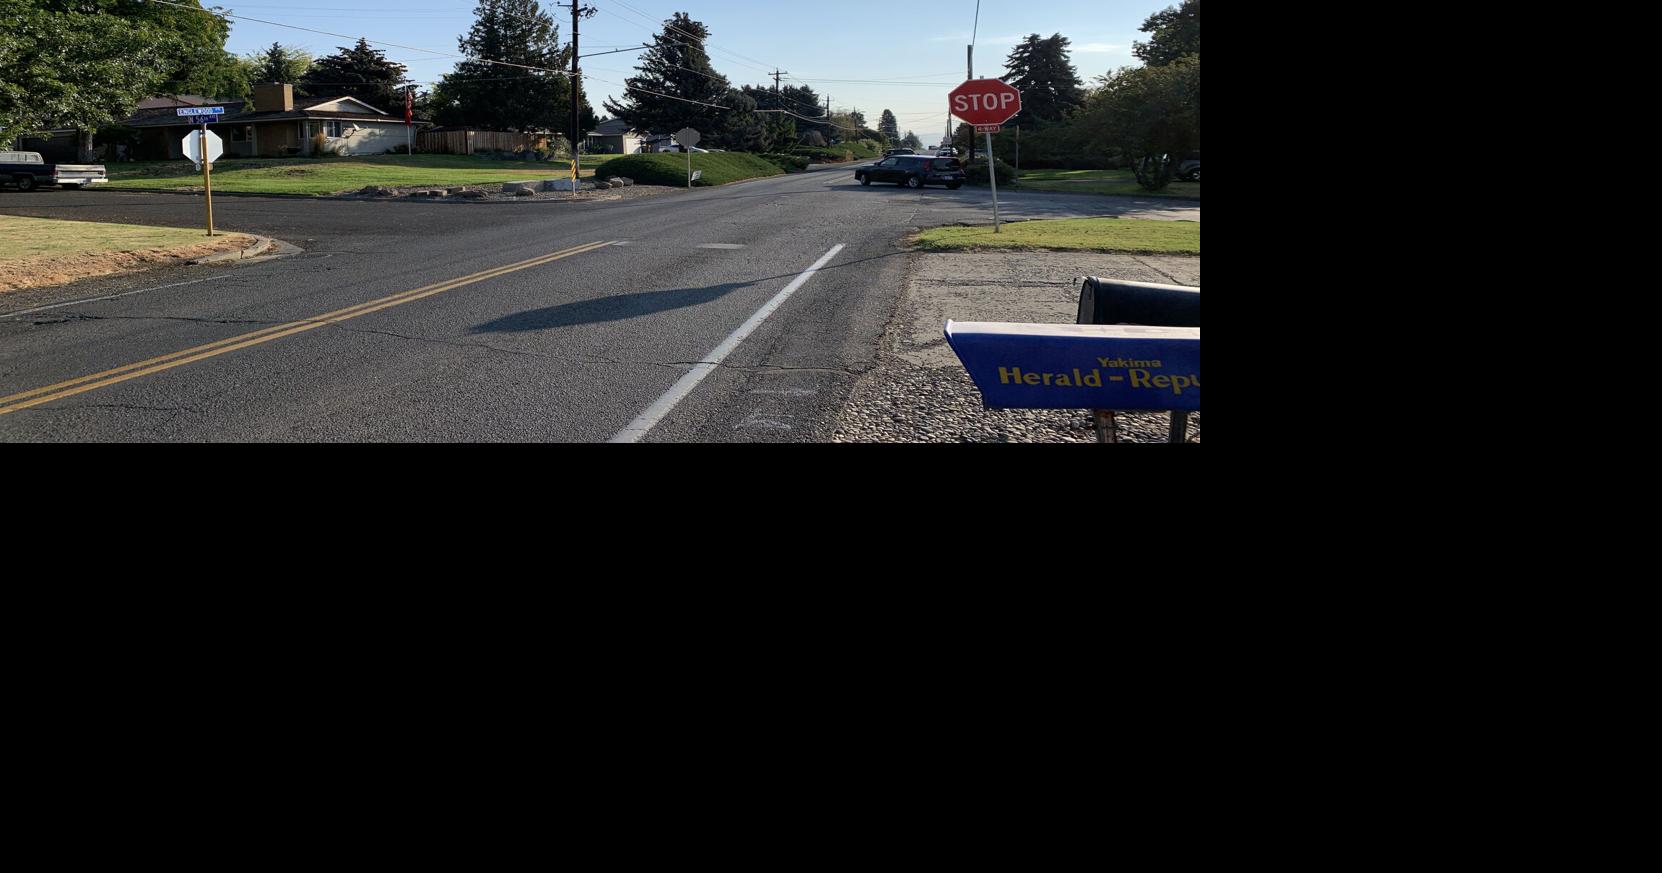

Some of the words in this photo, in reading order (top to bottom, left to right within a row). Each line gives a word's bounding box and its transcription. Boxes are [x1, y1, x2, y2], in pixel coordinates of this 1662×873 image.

[954, 93, 1015, 111] STOP
[1097, 357, 1162, 368] Yakima
[998, 367, 1101, 388] Herald
